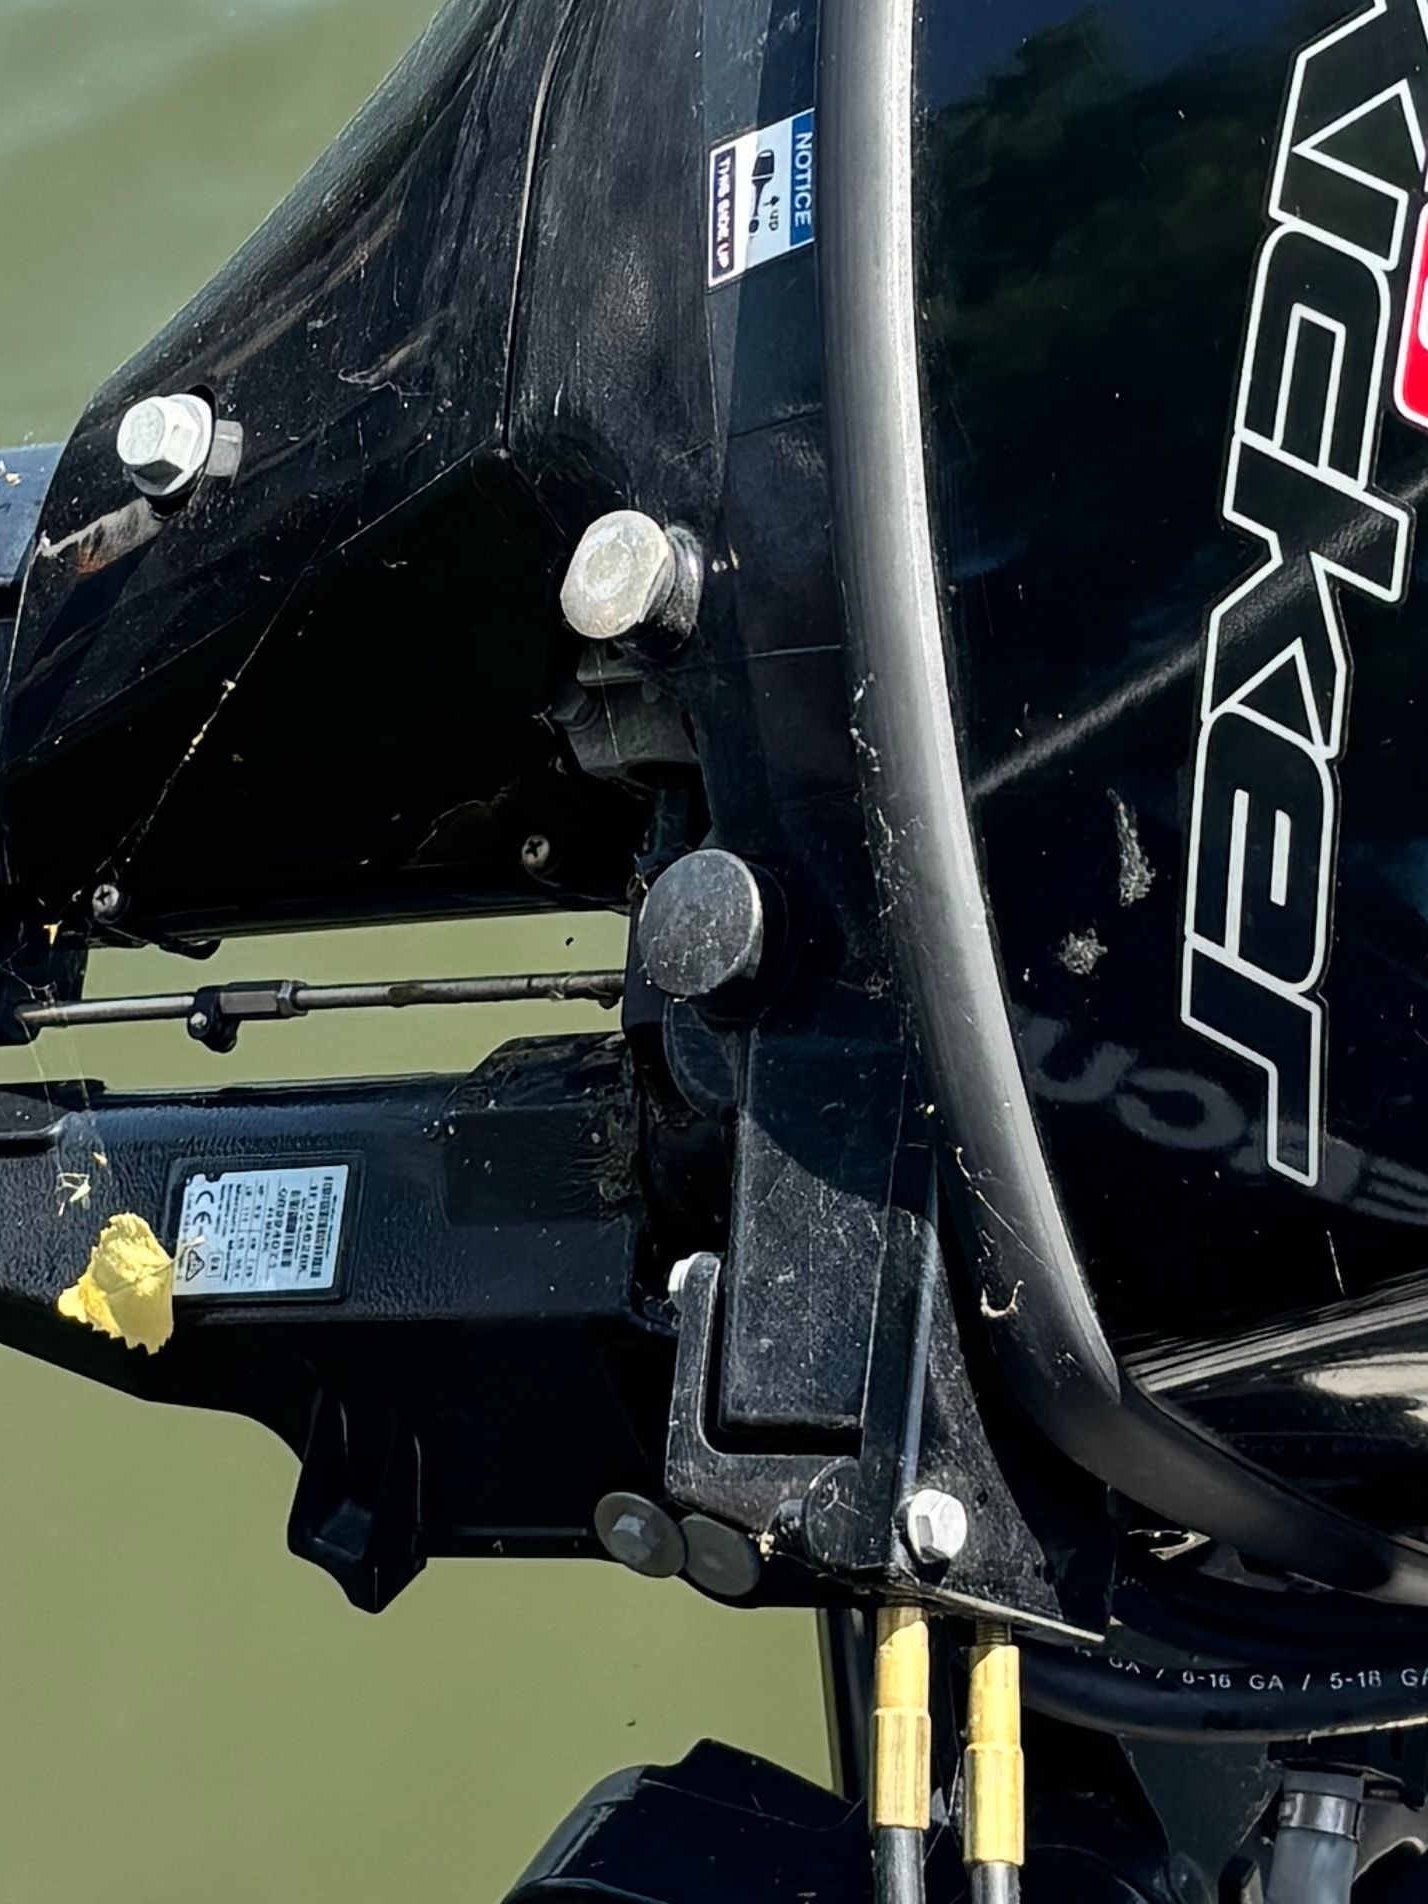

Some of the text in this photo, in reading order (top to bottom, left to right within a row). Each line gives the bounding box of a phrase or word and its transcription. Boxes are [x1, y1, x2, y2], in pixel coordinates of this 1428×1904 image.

[794, 132, 813, 228] NOTICE
[716, 242, 730, 268] UP
[1249, 1673, 1285, 1692] GA
[1301, 1673, 1312, 1692] /
[1329, 1670, 1382, 1690] 5-18
